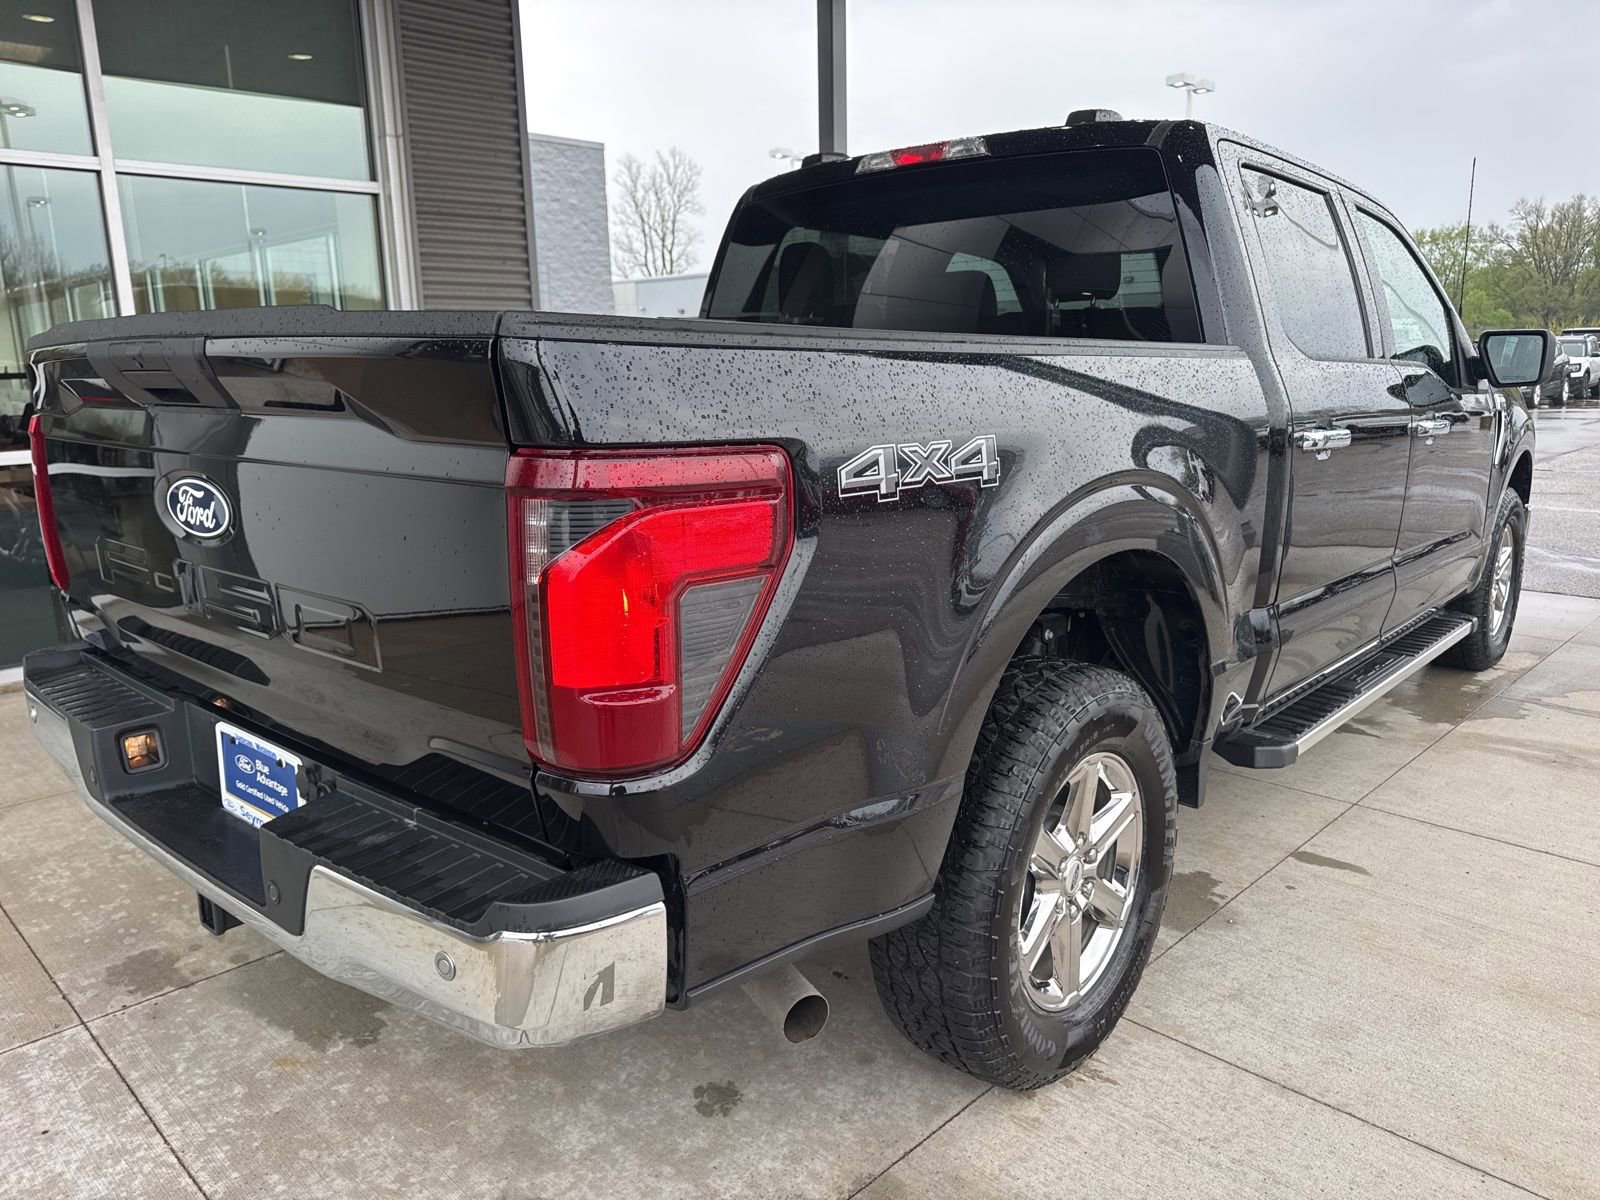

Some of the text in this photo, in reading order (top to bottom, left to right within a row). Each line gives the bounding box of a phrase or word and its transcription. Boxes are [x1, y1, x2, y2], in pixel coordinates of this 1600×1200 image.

[176, 485, 216, 529] Ford
[95, 535, 383, 673] F-150
[255, 759, 270, 775] Blue
[256, 772, 289, 797] Advantage
[1143, 722, 1175, 866] WRANGLER
